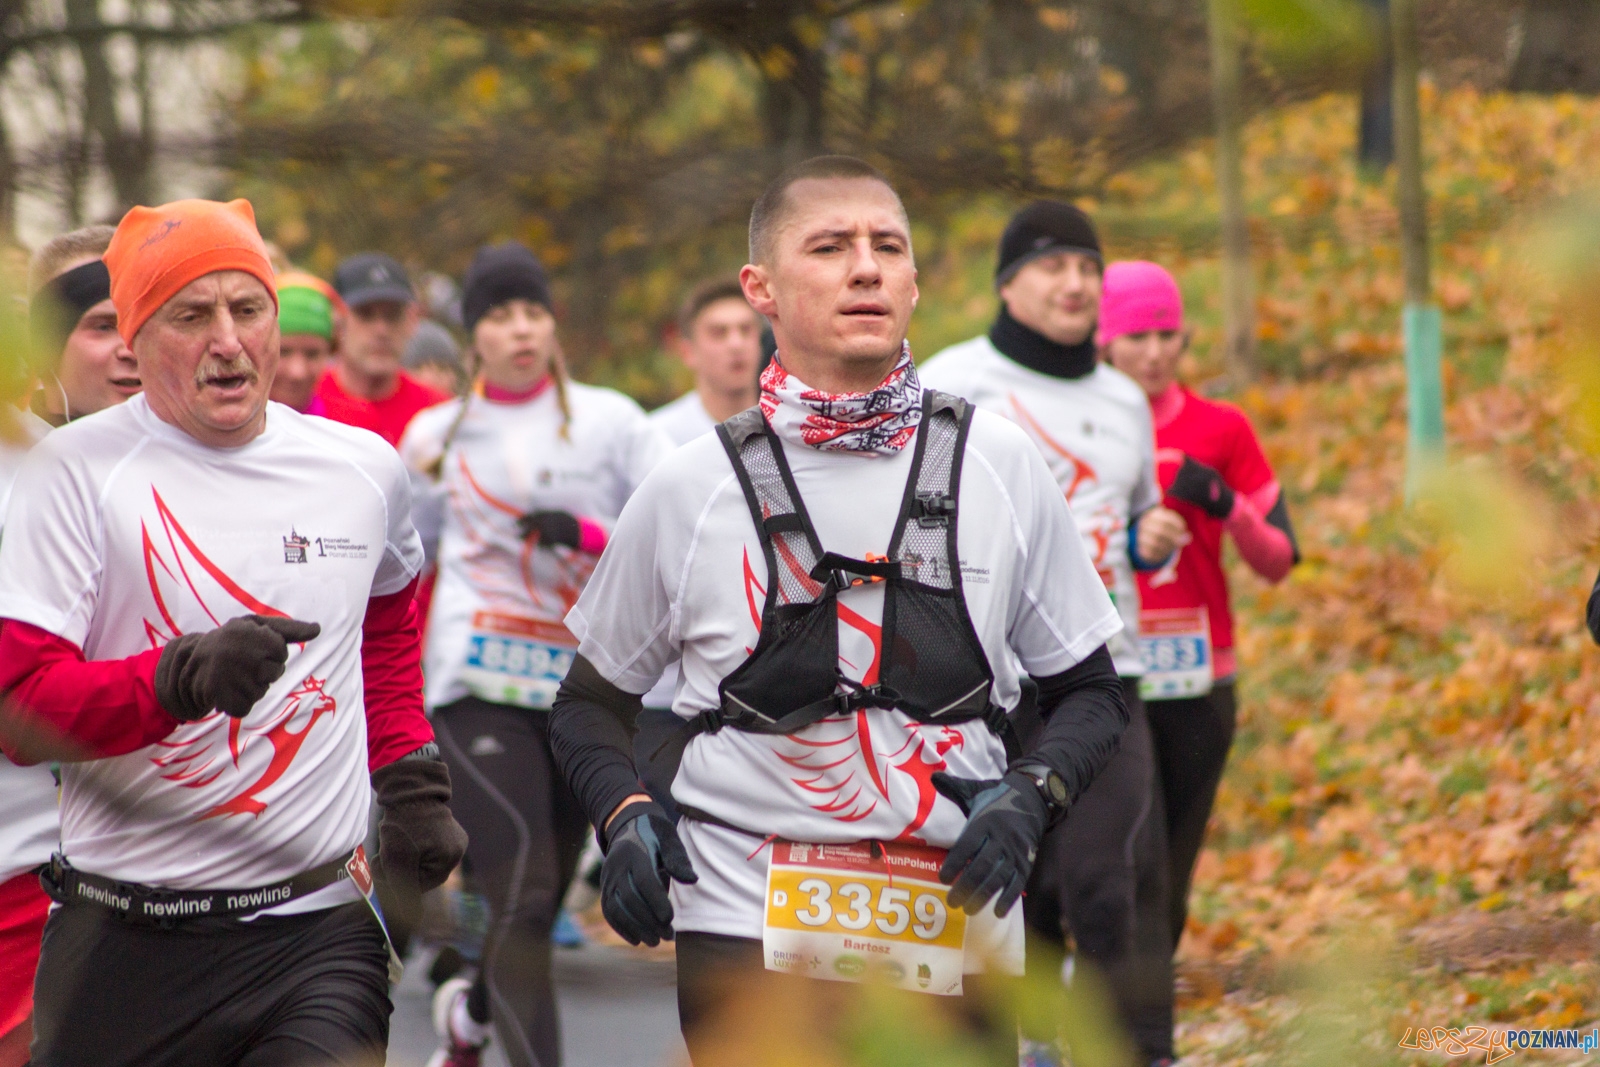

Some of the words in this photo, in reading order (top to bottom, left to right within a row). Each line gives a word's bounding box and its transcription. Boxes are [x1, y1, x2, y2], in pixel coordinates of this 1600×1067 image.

[315, 537, 327, 557] 1
[483, 641, 572, 677] 8894
[78, 881, 130, 910] newline
[144, 897, 212, 915] newline
[227, 884, 291, 910] newline
[772, 889, 788, 907] D
[795, 878, 948, 940] 3359
[843, 938, 891, 955] Bartosz
